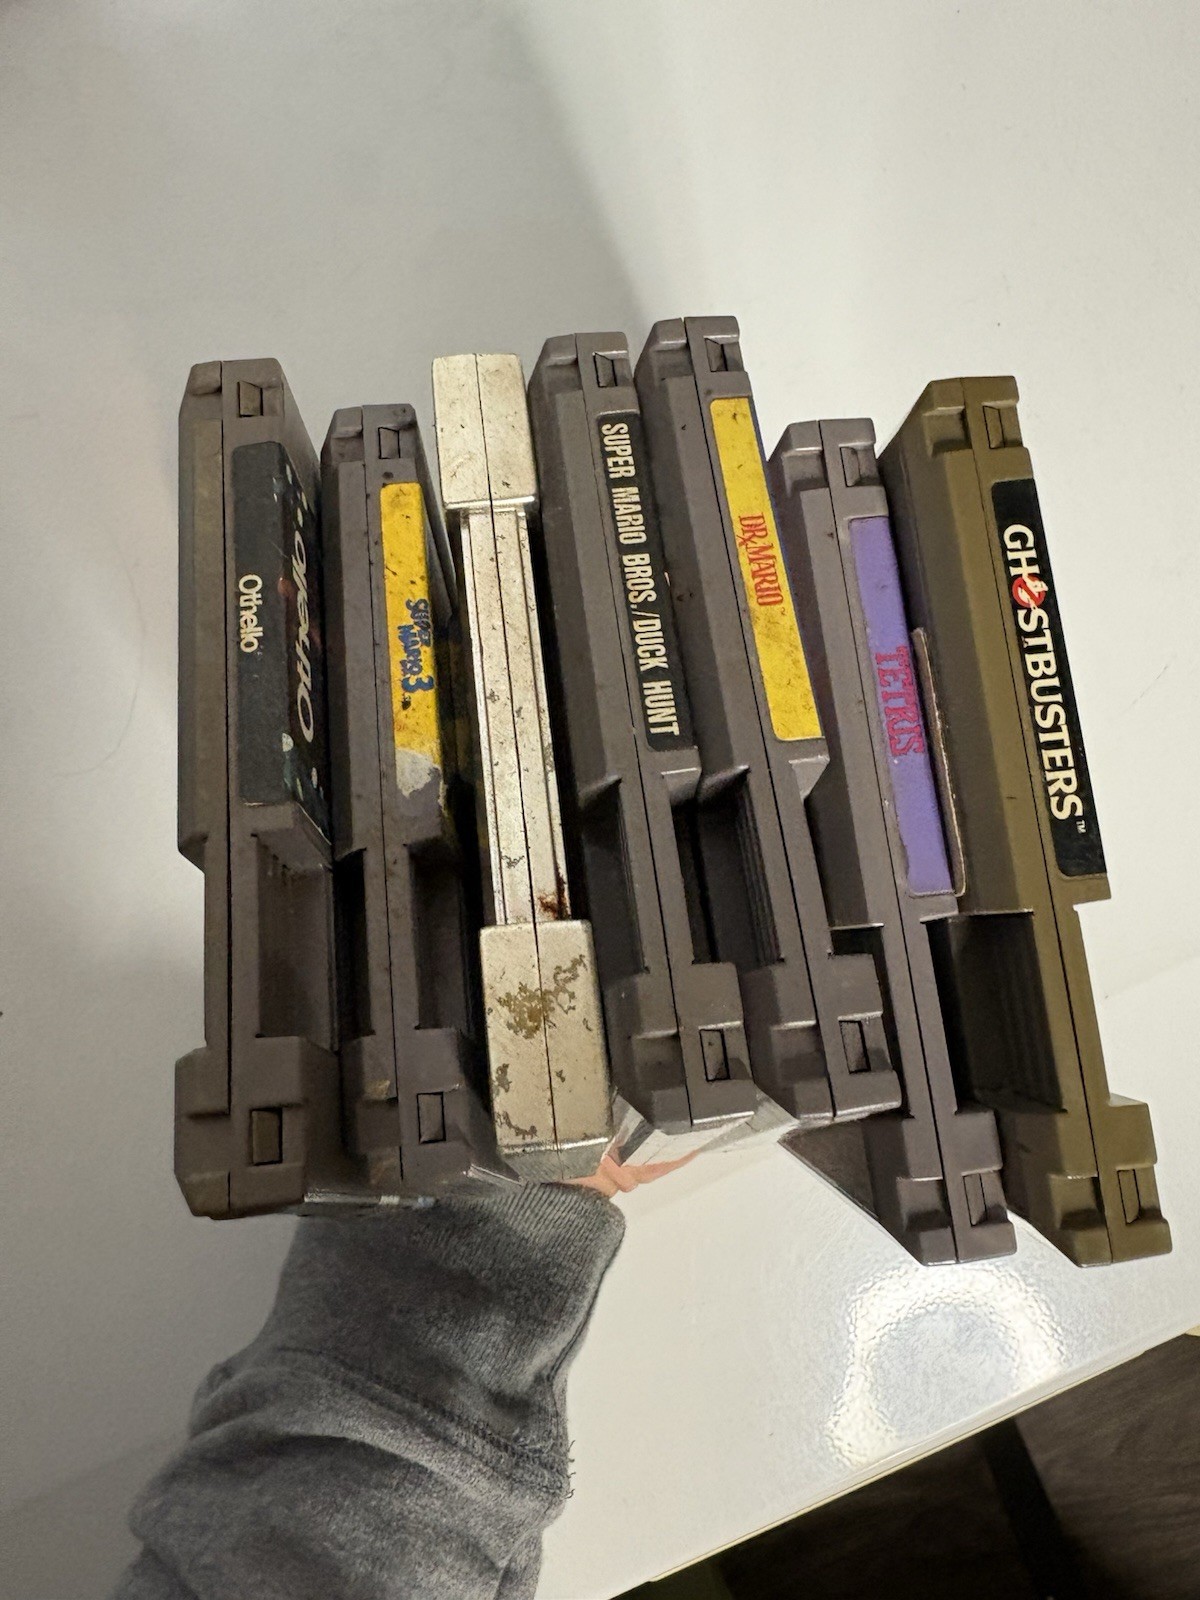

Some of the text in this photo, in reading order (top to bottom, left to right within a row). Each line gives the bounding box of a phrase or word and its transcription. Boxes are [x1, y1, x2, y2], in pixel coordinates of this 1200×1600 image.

[601, 422, 636, 480] SUPER
[611, 486, 648, 545] MARIO
[238, 573, 264, 653] Othello
[642, 680, 680, 737] HUNT
[875, 645, 926, 757] TETRIS
